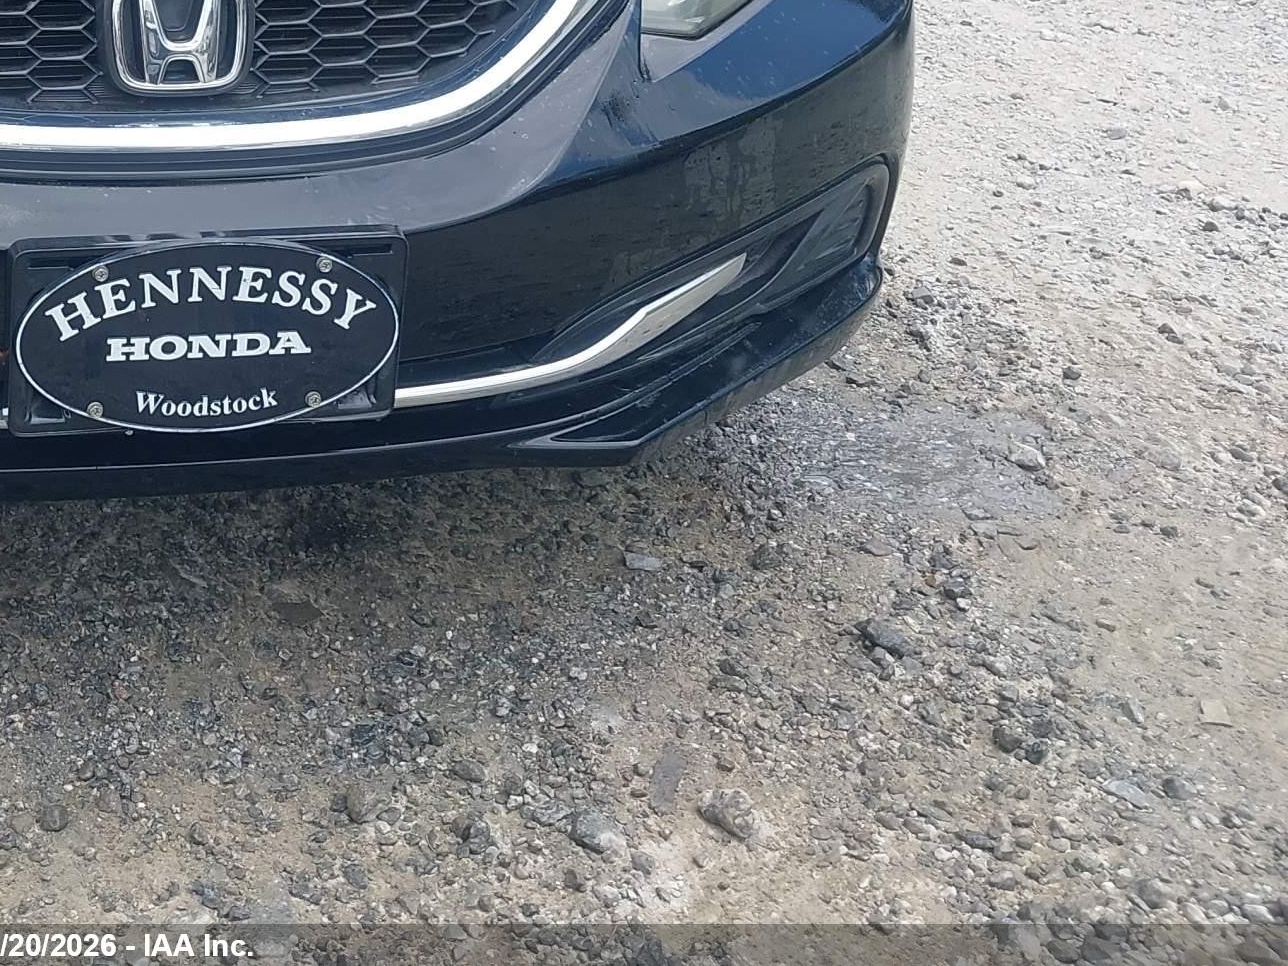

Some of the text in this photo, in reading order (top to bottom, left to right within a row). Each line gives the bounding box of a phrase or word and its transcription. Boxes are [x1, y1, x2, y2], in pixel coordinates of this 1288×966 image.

[44, 265, 377, 342] HENNESSY
[105, 330, 312, 362] HONDA
[135, 386, 279, 418] Woodstock
